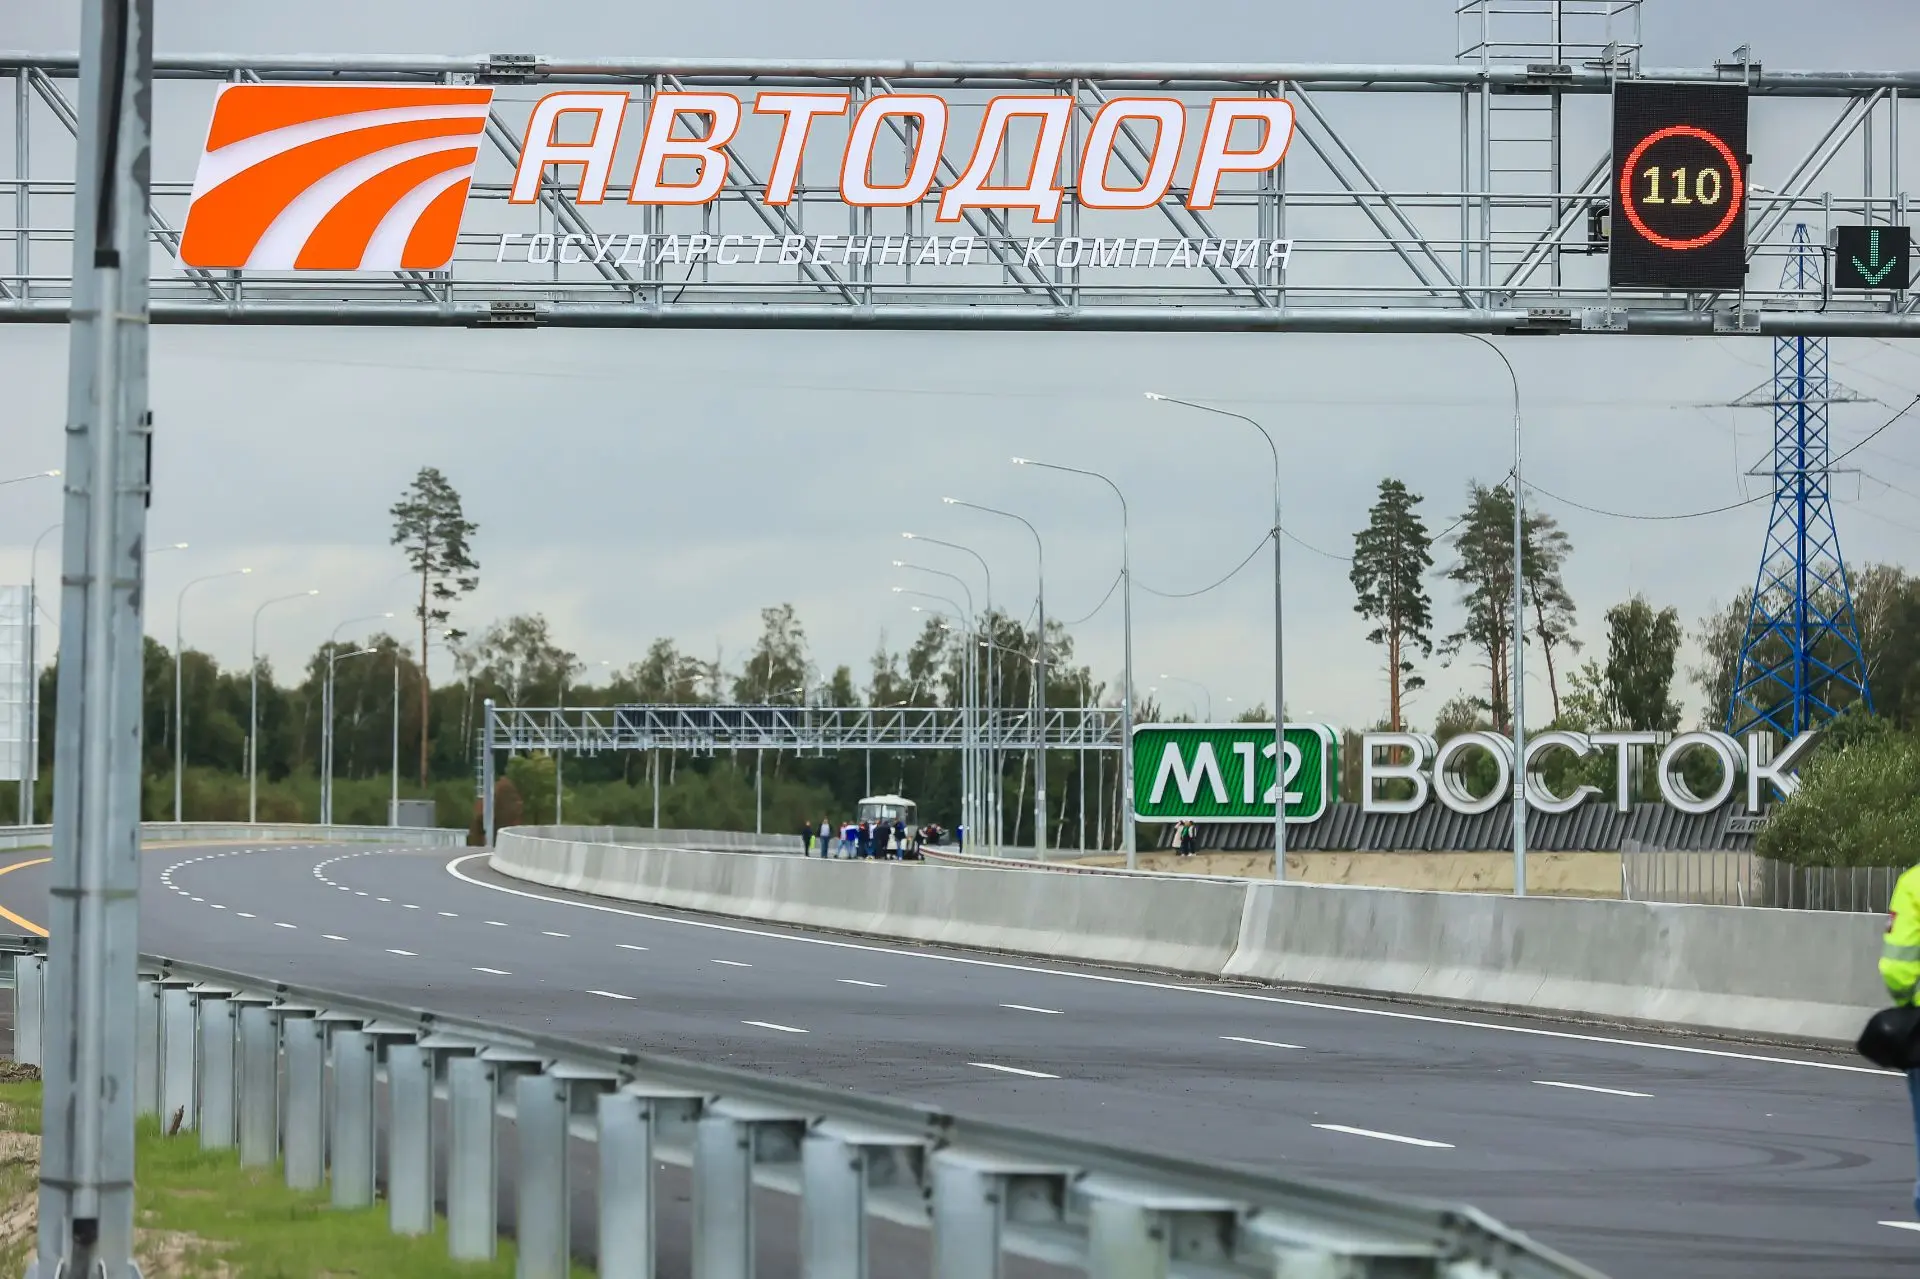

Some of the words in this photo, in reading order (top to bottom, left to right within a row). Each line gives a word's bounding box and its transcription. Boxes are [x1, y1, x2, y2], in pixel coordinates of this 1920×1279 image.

[508, 91, 1296, 223] АВТОДОР
[1642, 166, 1722, 205] 110
[496, 233, 976, 268] ГОСУДАРСТВЕННАЯ
[1022, 236, 1294, 270] КОМПАНИЯ
[1149, 741, 1304, 805] М12
[1362, 730, 1819, 815] ВОСТОК
